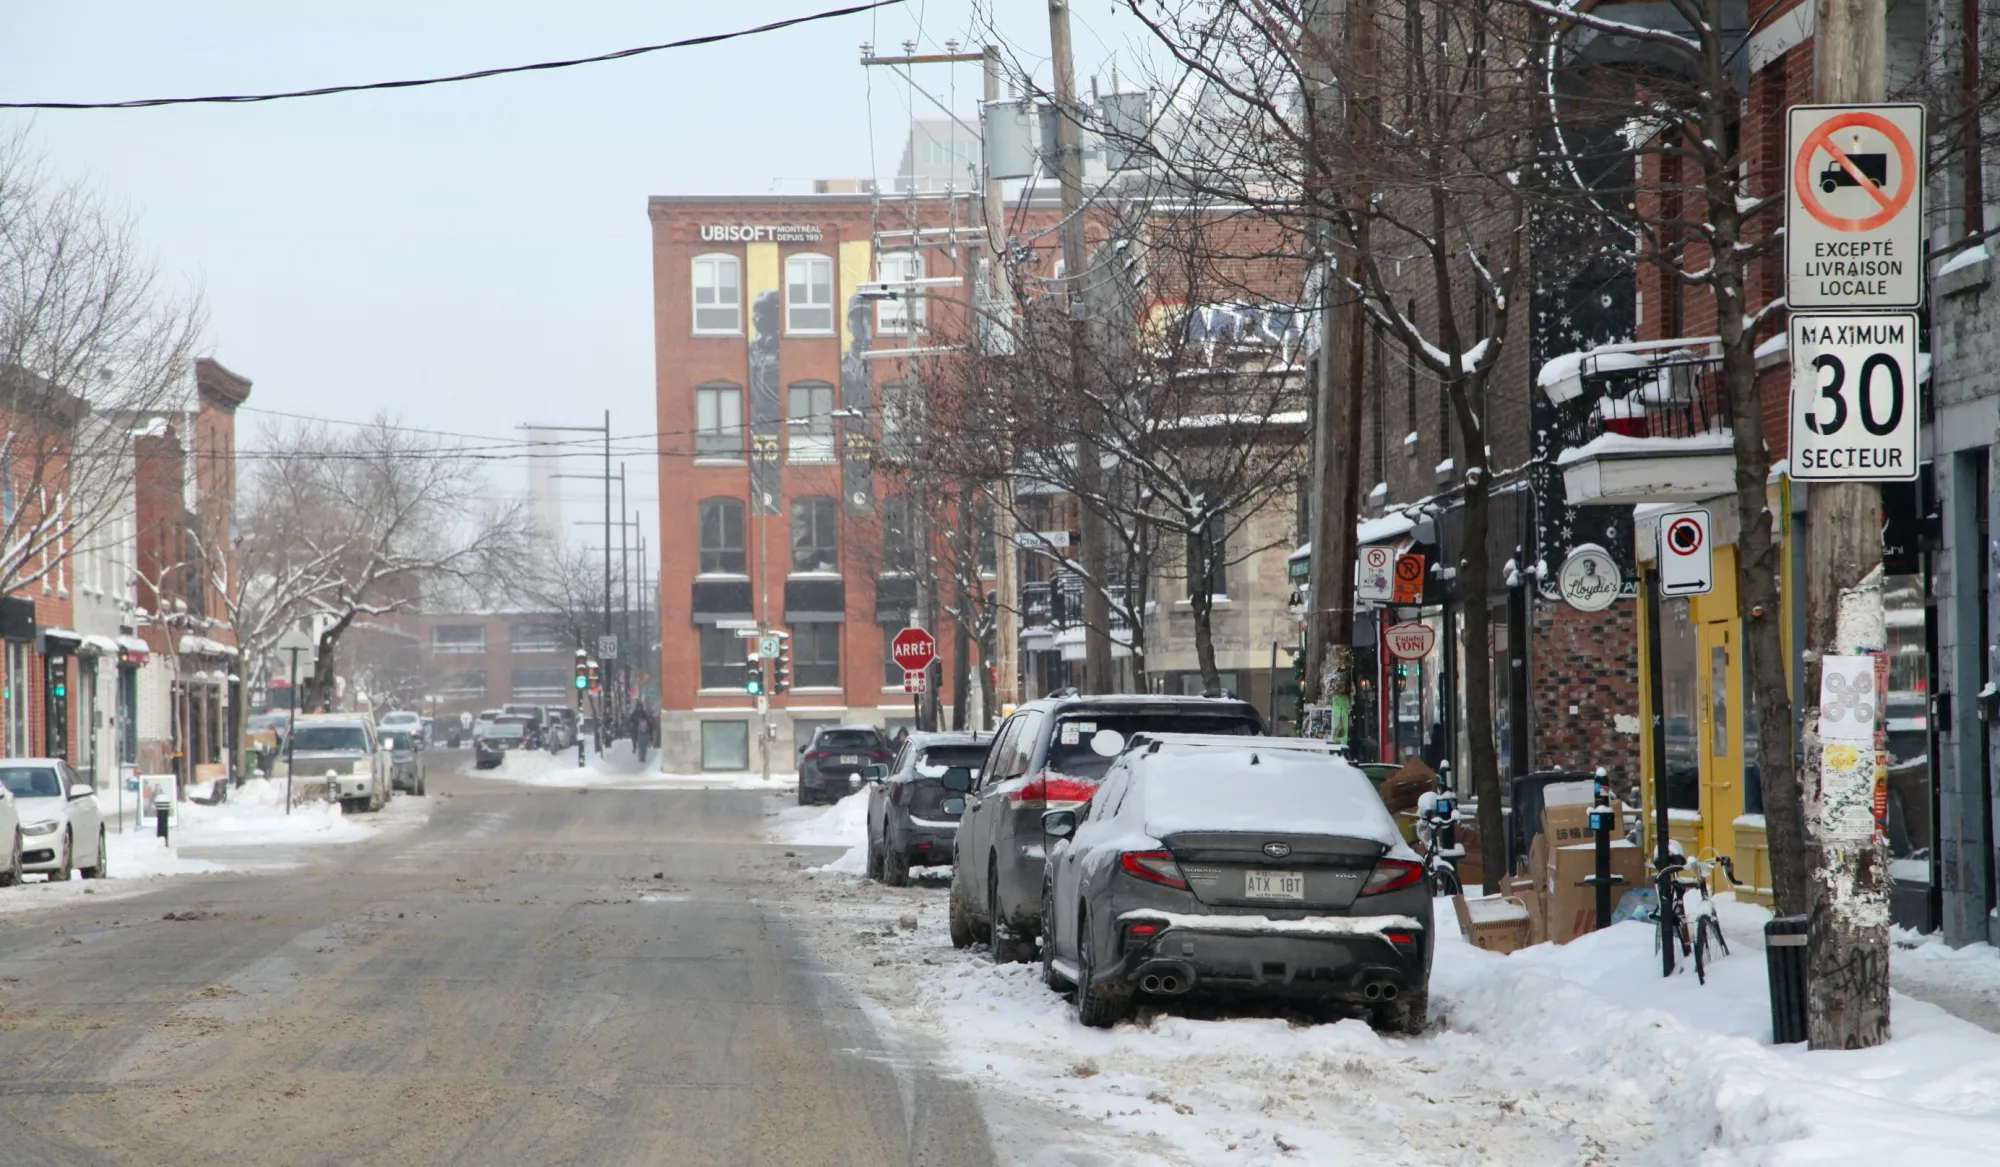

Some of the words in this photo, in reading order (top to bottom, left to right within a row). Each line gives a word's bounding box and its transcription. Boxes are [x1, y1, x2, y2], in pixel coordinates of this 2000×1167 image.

[701, 225, 776, 241] UBISOFT
[777, 224, 821, 233] MONTRÉAL
[777, 233, 805, 241] DEPUIS
[806, 233, 823, 241] 1997
[1815, 239, 1893, 257] EXCEPTÉ
[1806, 261, 1902, 276] LIVRAISON
[1820, 281, 1887, 295] LOCALE
[1802, 325, 1904, 345] MAXIMUM
[1804, 352, 1904, 436] 30
[1802, 448, 1902, 468] SECTEUR
[1567, 580, 1617, 600] Lloydie's
[895, 640, 932, 656] ARRÊT
[1395, 642, 1425, 652] YONI
[1248, 877, 1270, 891] ATX
